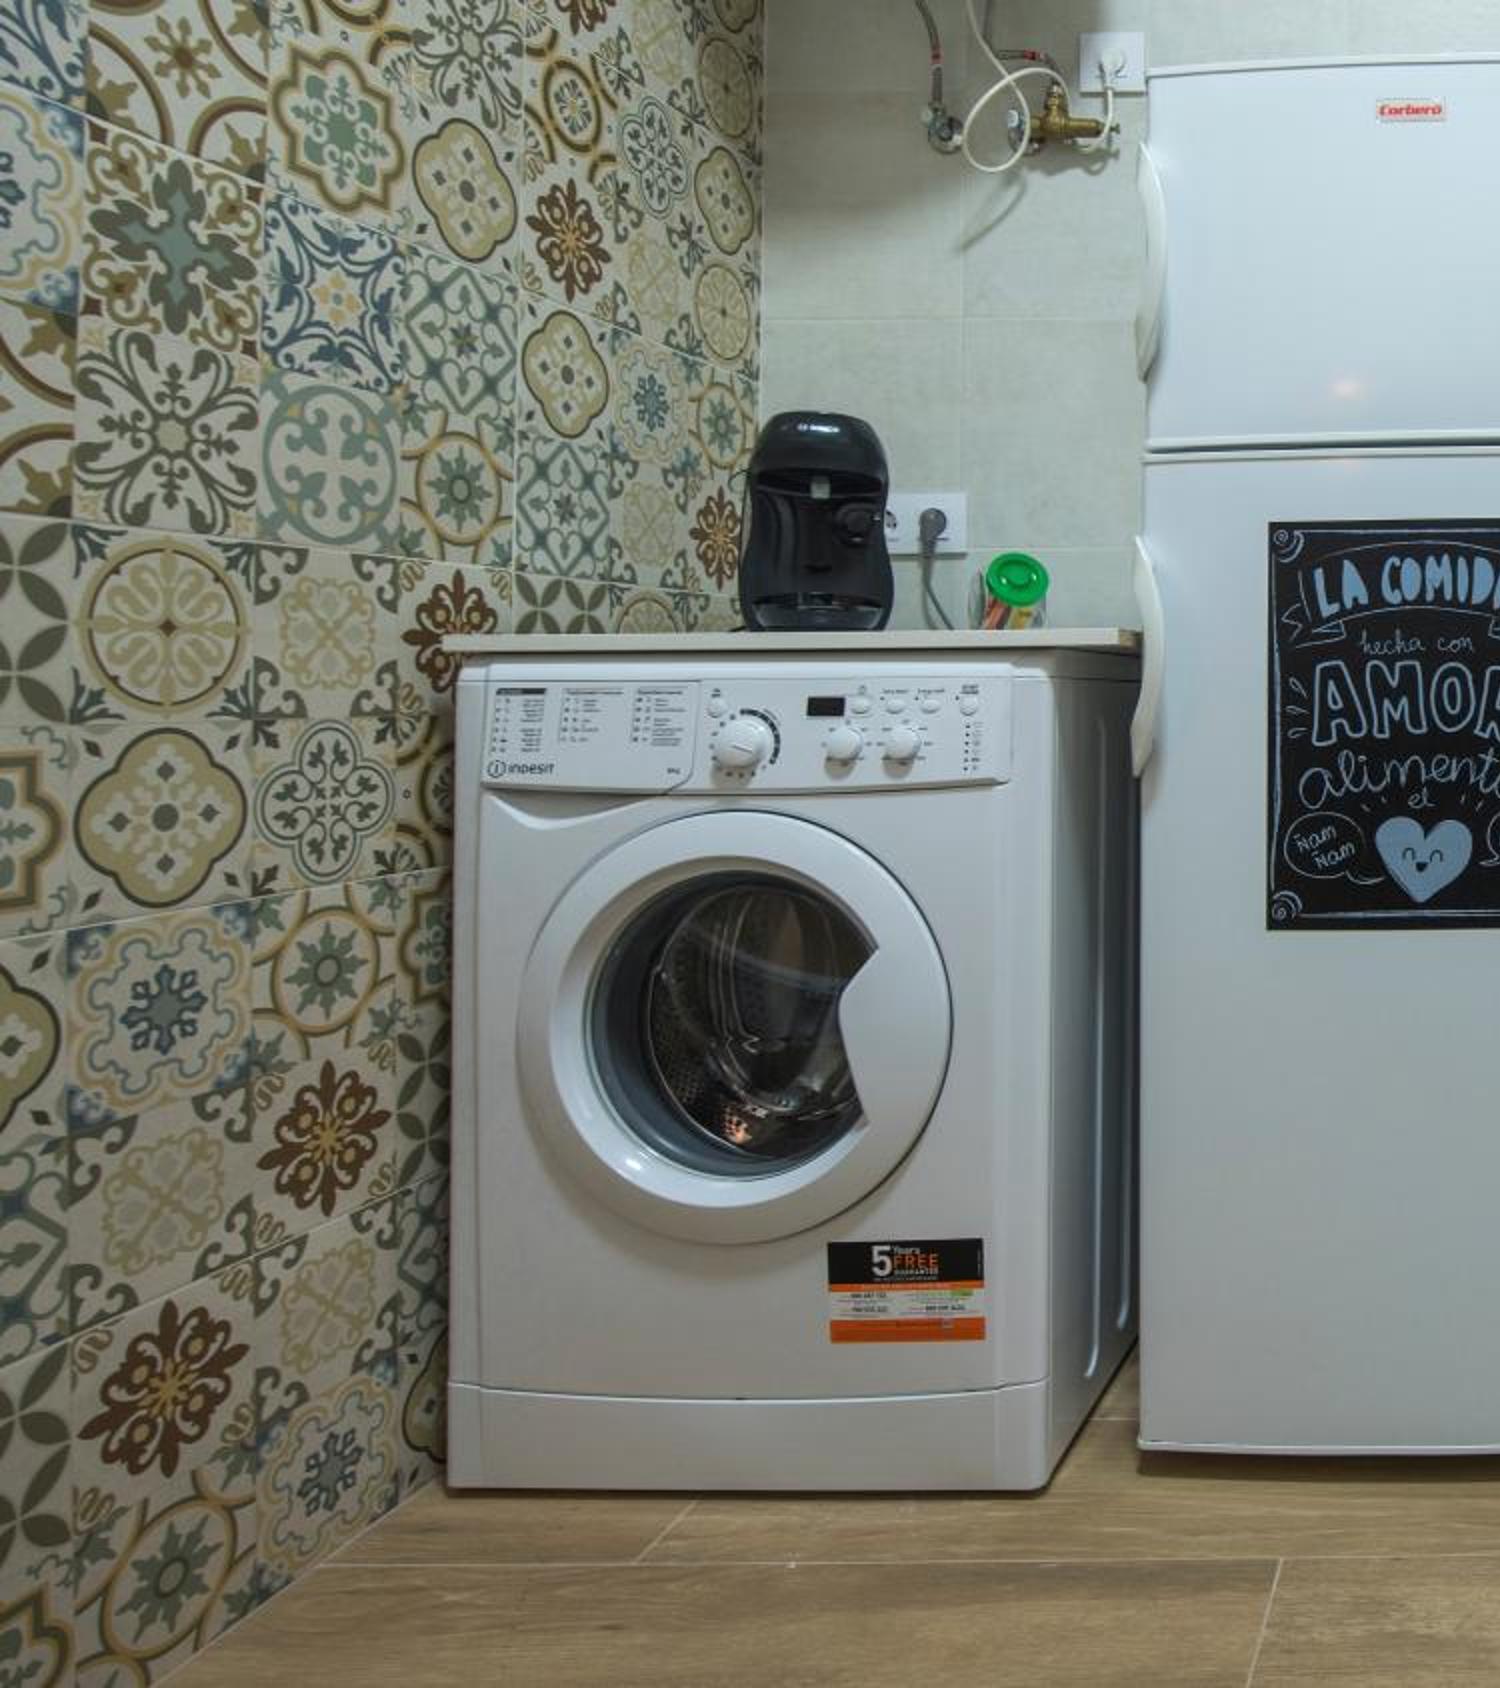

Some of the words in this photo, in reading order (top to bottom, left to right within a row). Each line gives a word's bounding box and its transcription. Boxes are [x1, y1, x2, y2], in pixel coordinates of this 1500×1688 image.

[1313, 558, 1369, 618] LA
[1360, 629, 1427, 655] hecha
[1437, 637, 1475, 653] con
[1407, 786, 1436, 809] el
[871, 1245, 893, 1277] 5
[893, 1254, 939, 1268] FREE
